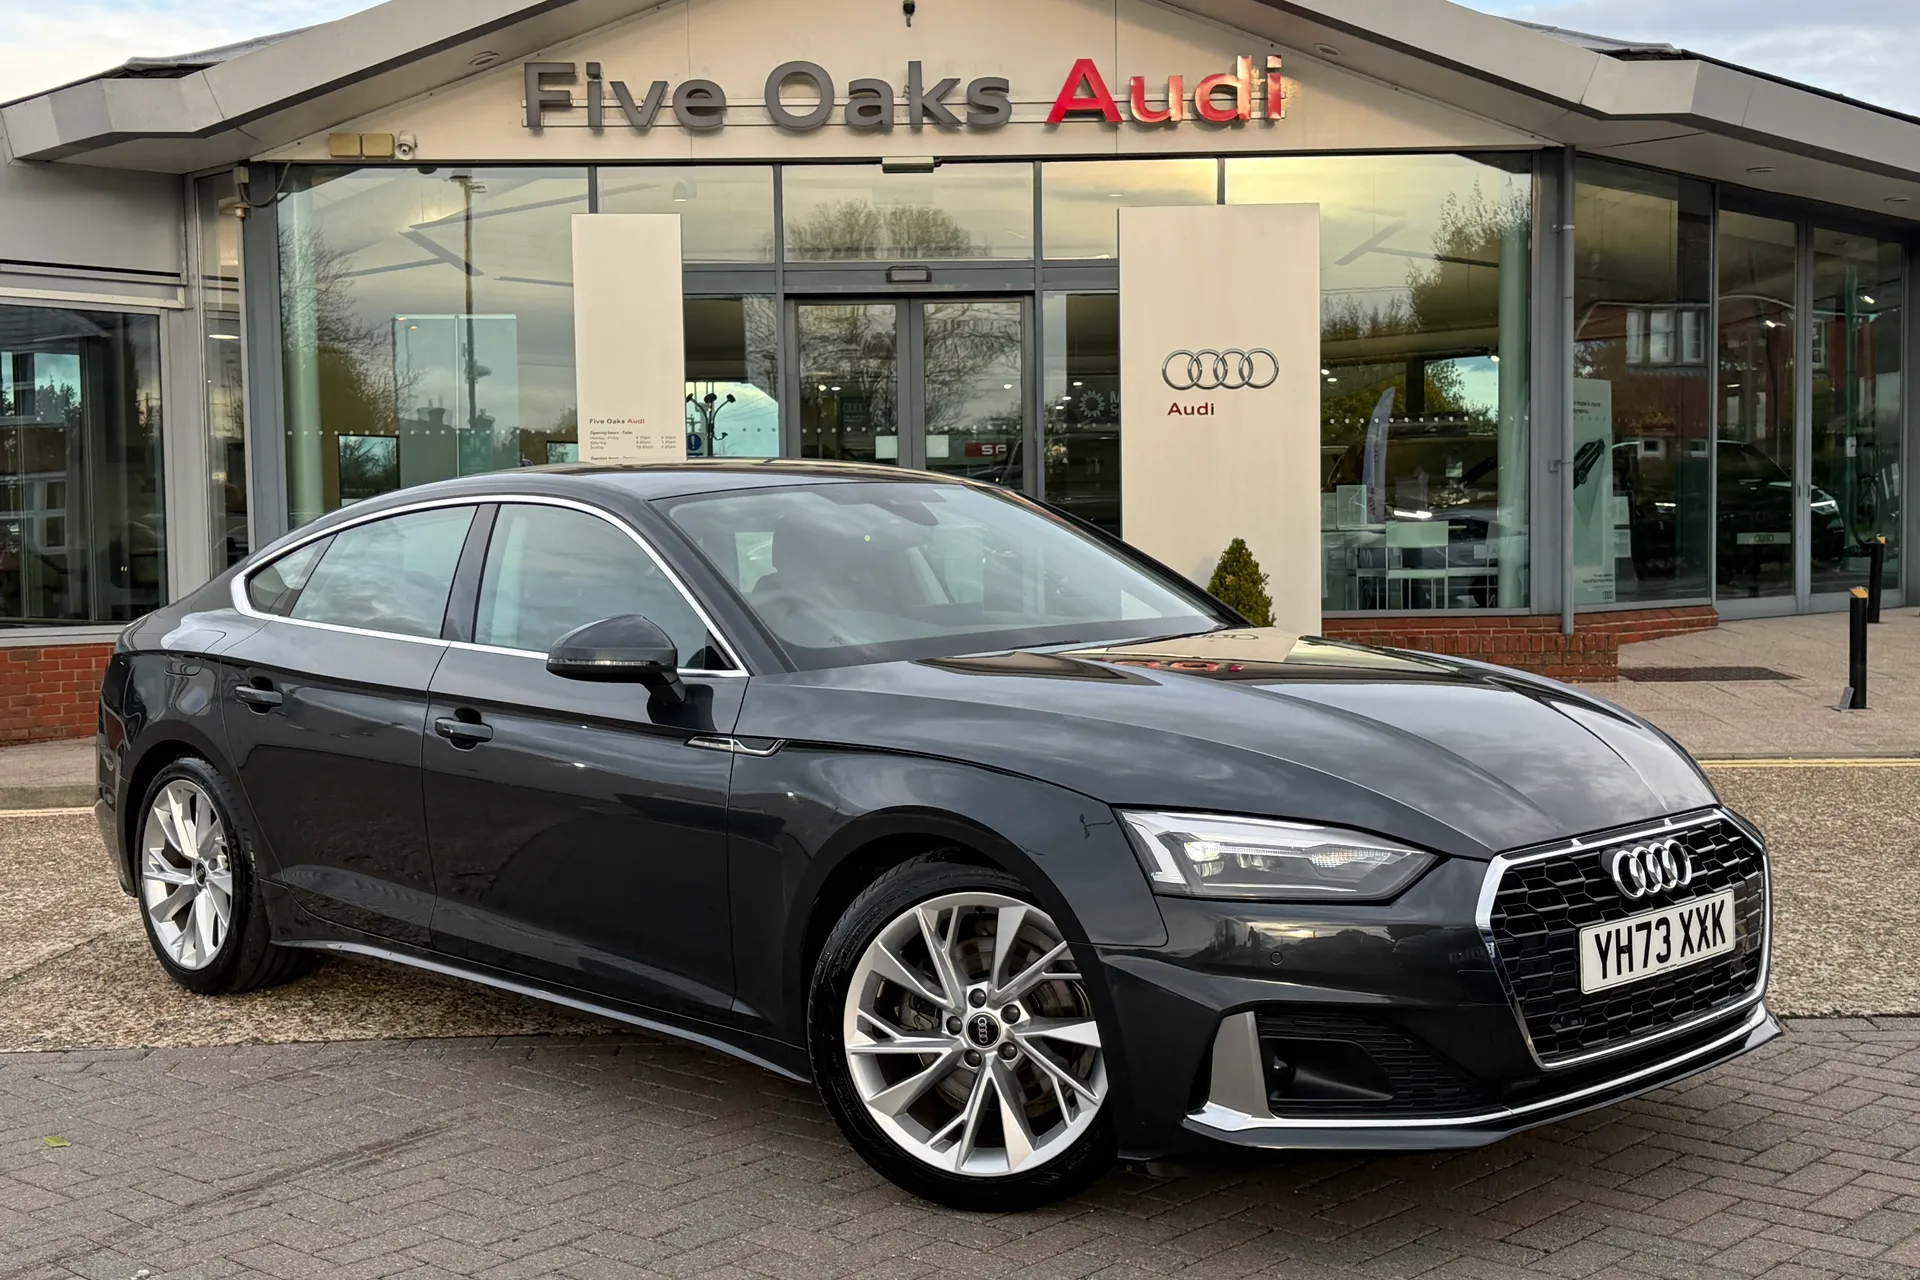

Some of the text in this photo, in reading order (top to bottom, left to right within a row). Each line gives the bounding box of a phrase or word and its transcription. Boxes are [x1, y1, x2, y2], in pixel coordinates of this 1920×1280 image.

[524, 55, 1283, 129] Five Oaks Audi
[1167, 402, 1215, 416] Audi
[1594, 899, 1727, 979] YH73 XXK
